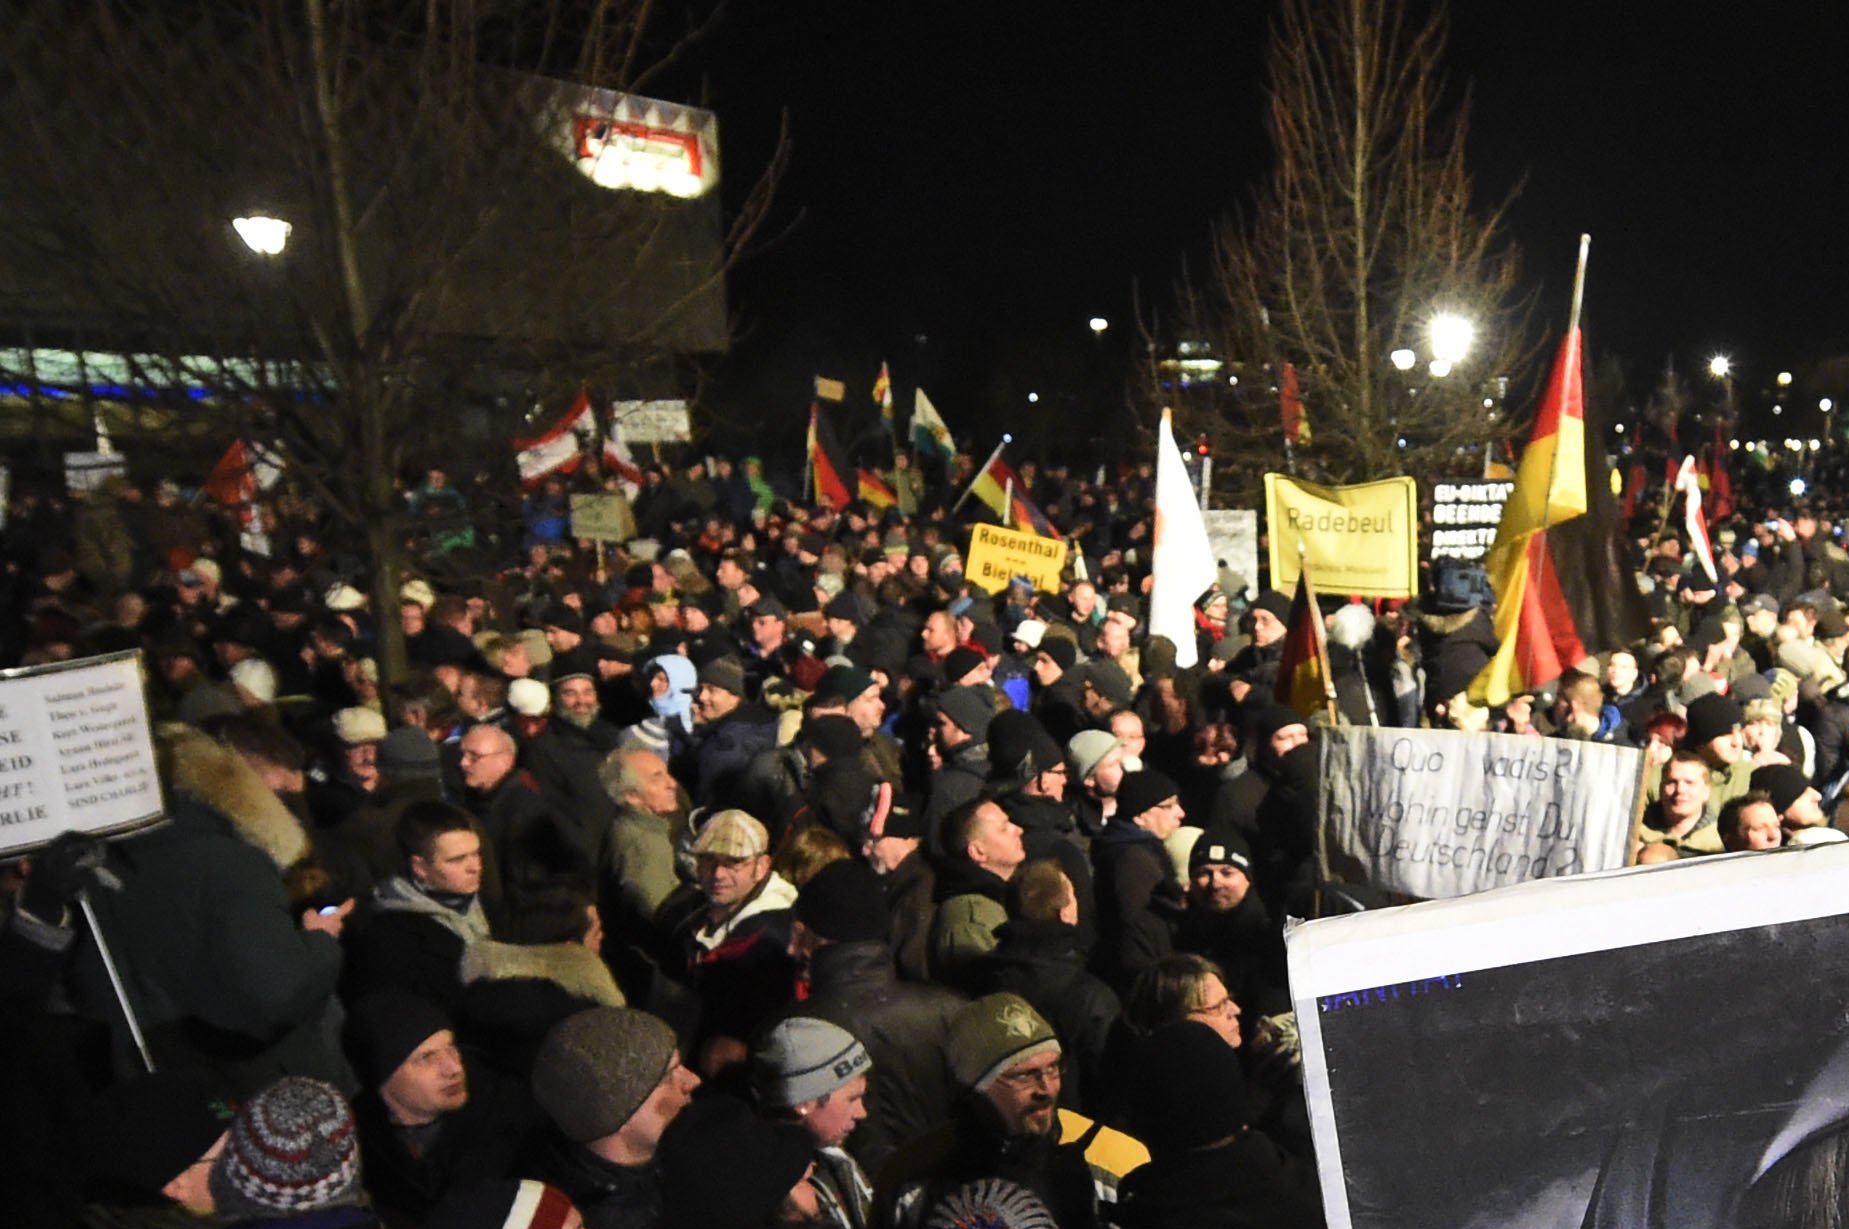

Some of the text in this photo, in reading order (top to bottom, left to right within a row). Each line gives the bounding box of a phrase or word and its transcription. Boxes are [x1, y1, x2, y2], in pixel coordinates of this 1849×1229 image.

[1287, 507, 1392, 534] Radebeul
[979, 528, 1059, 558] Rosenthal
[982, 562, 1044, 588] Bielal
[1392, 737, 1444, 776] Quo
[1455, 799, 1531, 836] gehst
